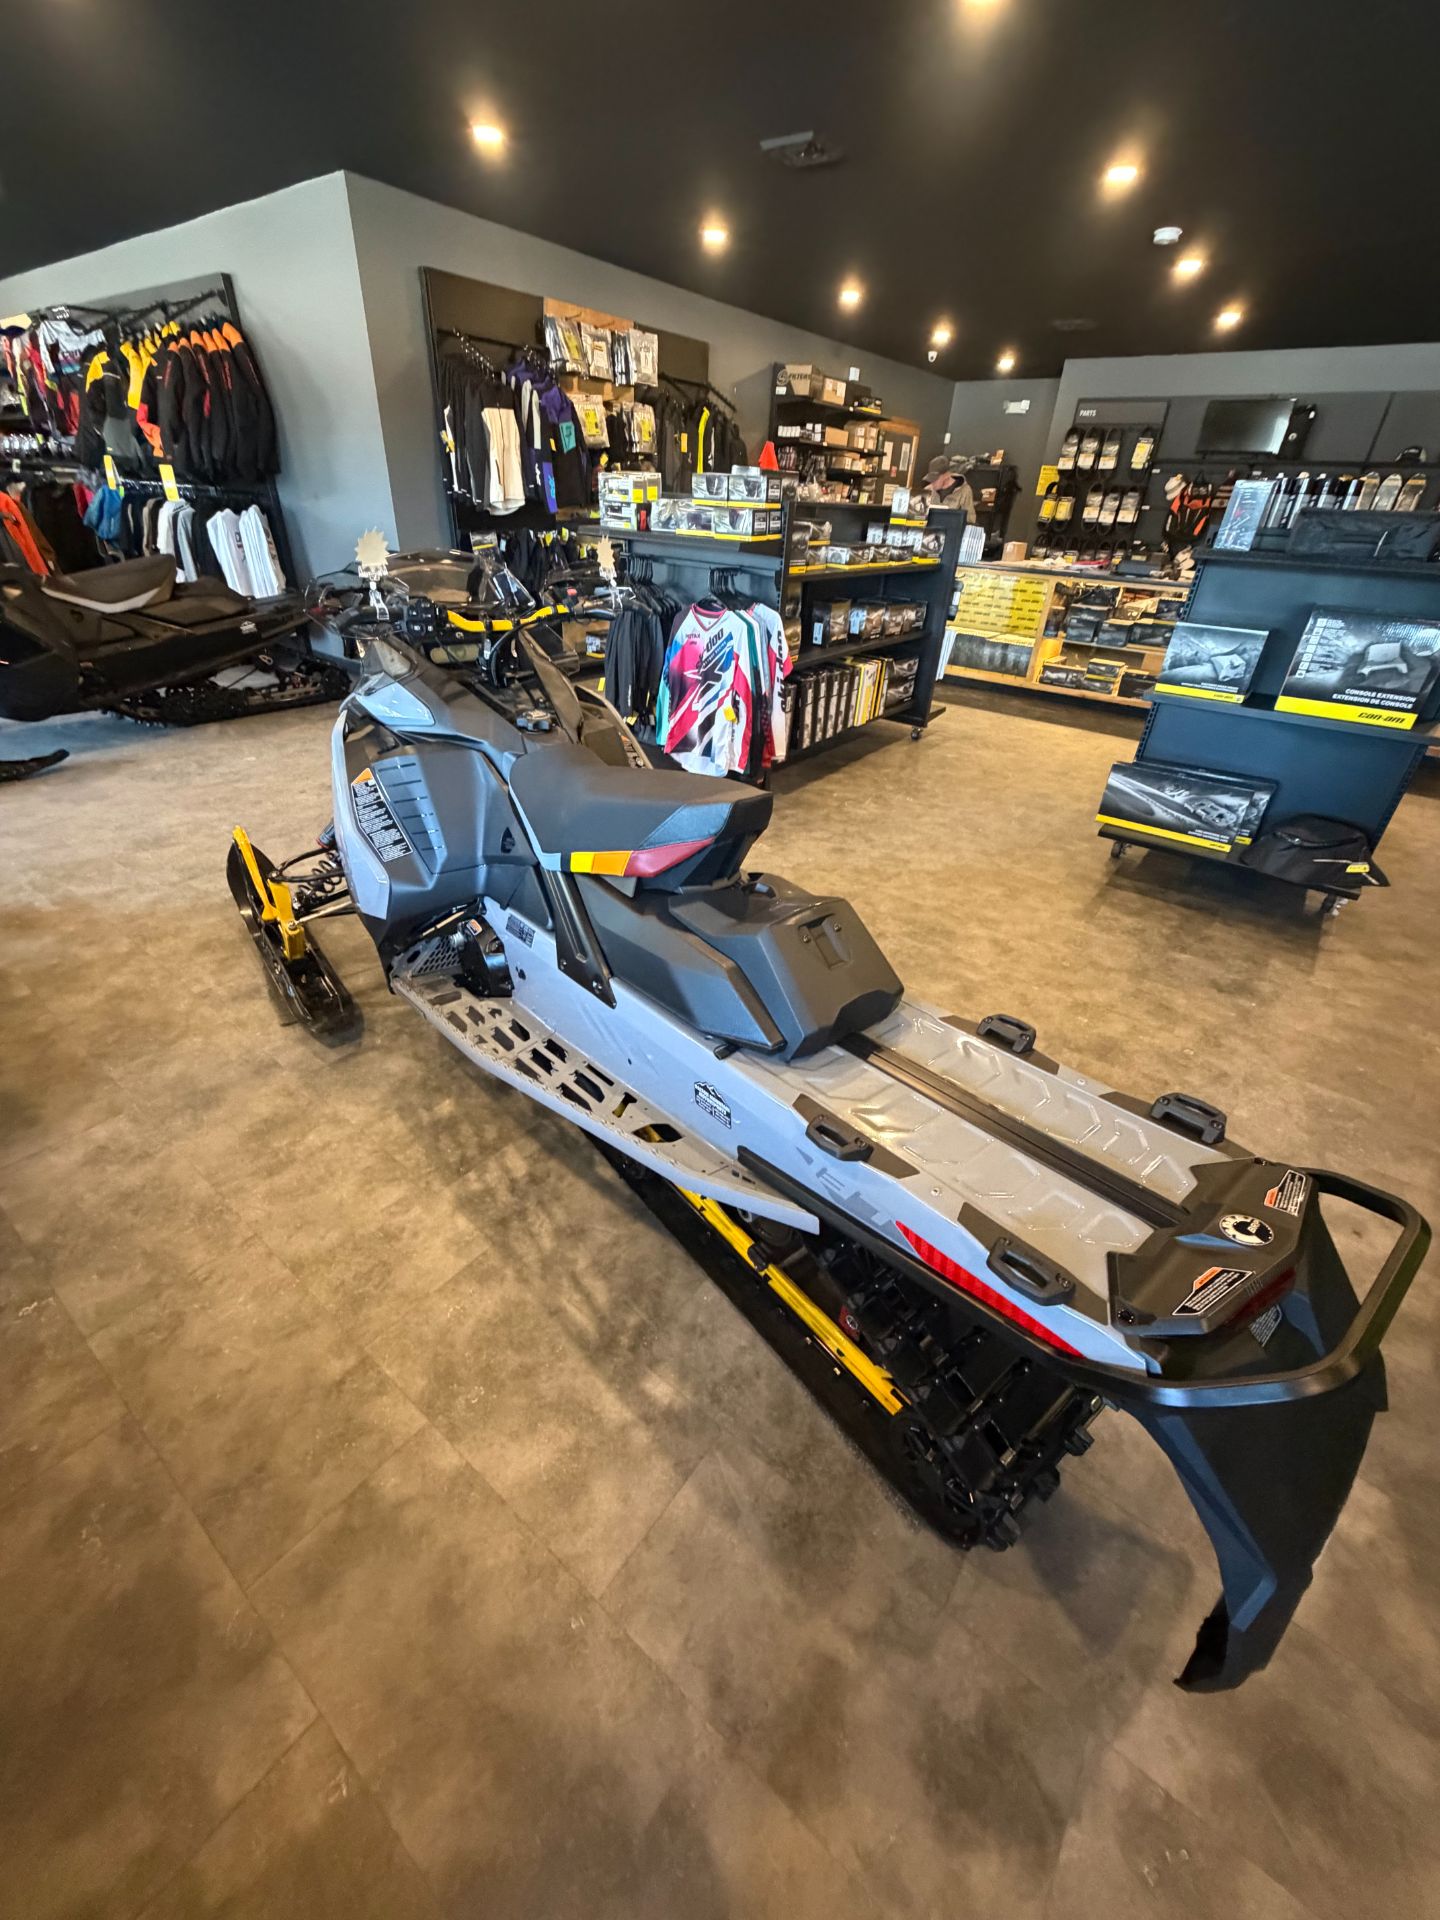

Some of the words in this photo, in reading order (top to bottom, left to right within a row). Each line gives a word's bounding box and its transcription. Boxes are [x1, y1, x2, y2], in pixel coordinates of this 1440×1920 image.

[1079, 409, 1097, 417] PARTS
[1332, 693, 1370, 704] EXTENSION
[1380, 699, 1414, 709] CONSOLE
[1345, 688, 1377, 698] CONSOLE
[1378, 692, 1417, 703] EXTENSION
[1358, 712, 1406, 724] can-am
